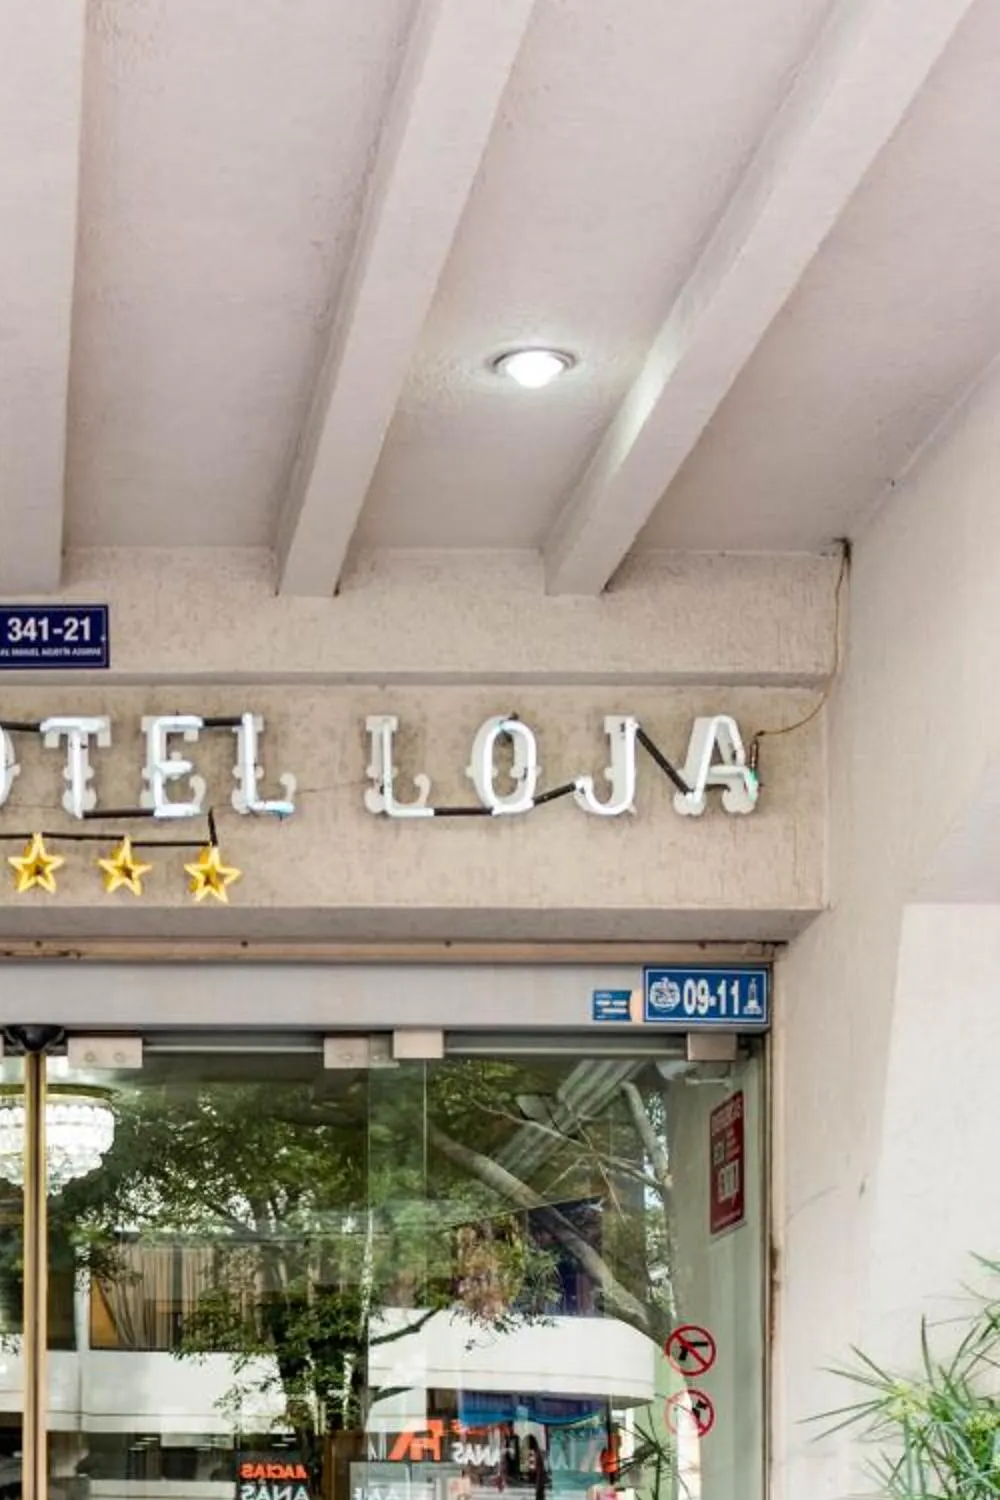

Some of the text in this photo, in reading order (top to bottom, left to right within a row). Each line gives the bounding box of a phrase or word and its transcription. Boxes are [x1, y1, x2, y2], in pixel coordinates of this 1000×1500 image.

[6, 616, 91, 643] 341-21
[364, 713, 761, 818] LOJA
[683, 977, 740, 1016] 09-11
